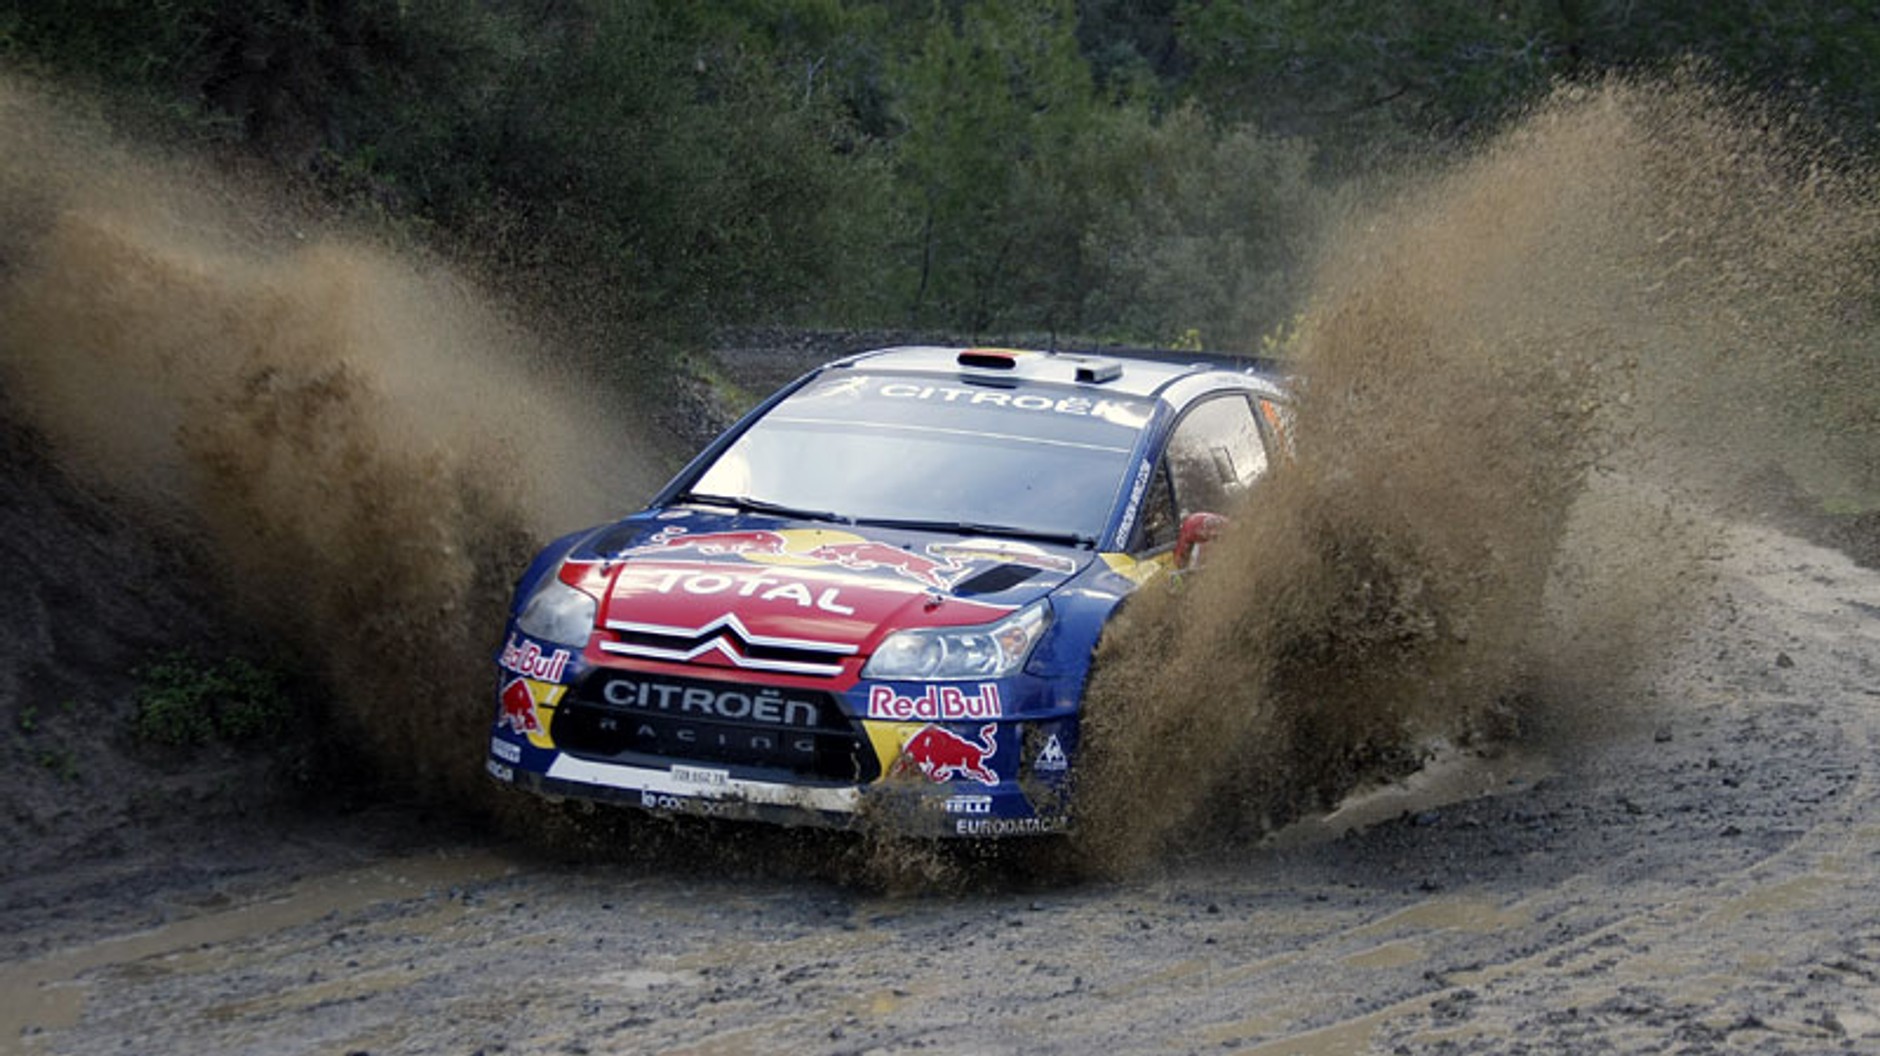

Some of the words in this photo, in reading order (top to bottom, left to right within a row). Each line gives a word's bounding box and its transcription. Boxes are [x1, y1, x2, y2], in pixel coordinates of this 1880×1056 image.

[656, 568, 855, 615] TOTAL
[516, 640, 570, 683] Bull
[868, 685, 939, 719] Red
[940, 683, 1001, 718] Bull
[599, 718, 815, 751] RACING
